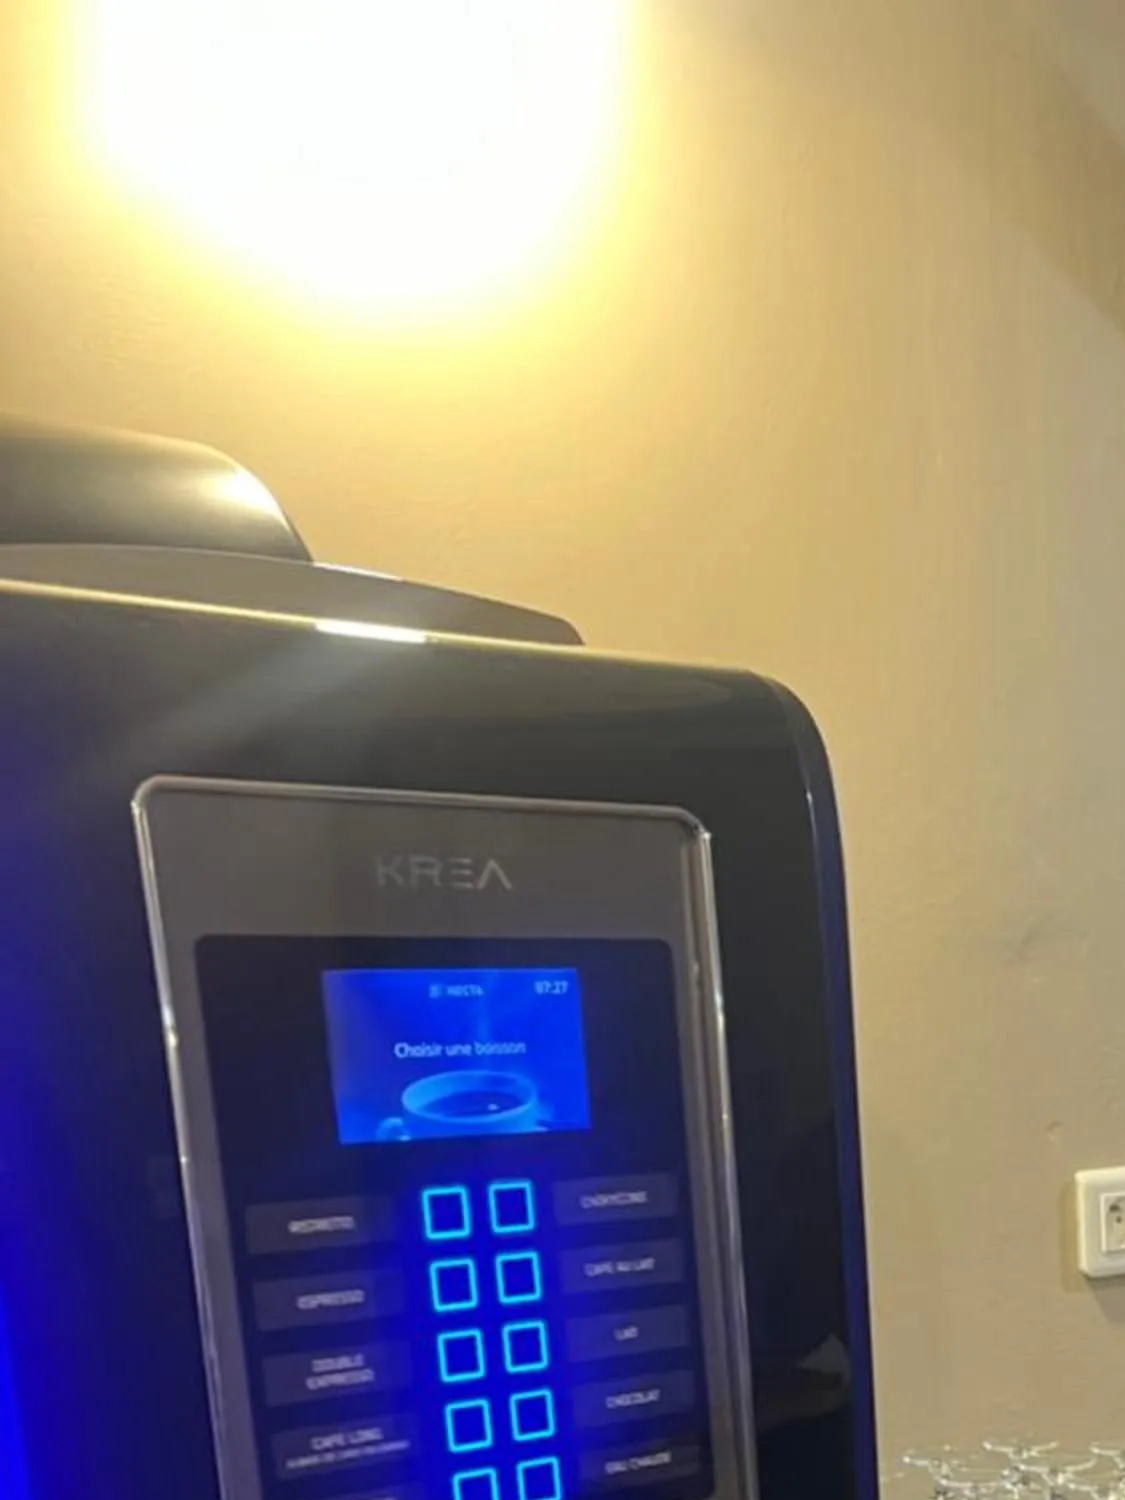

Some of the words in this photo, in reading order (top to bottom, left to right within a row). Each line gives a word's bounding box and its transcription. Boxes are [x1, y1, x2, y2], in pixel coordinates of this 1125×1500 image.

[377, 855, 513, 890] KREA
[394, 1041, 443, 1059] Choisir
[445, 1043, 473, 1057] une
[474, 1041, 527, 1056] boisson
